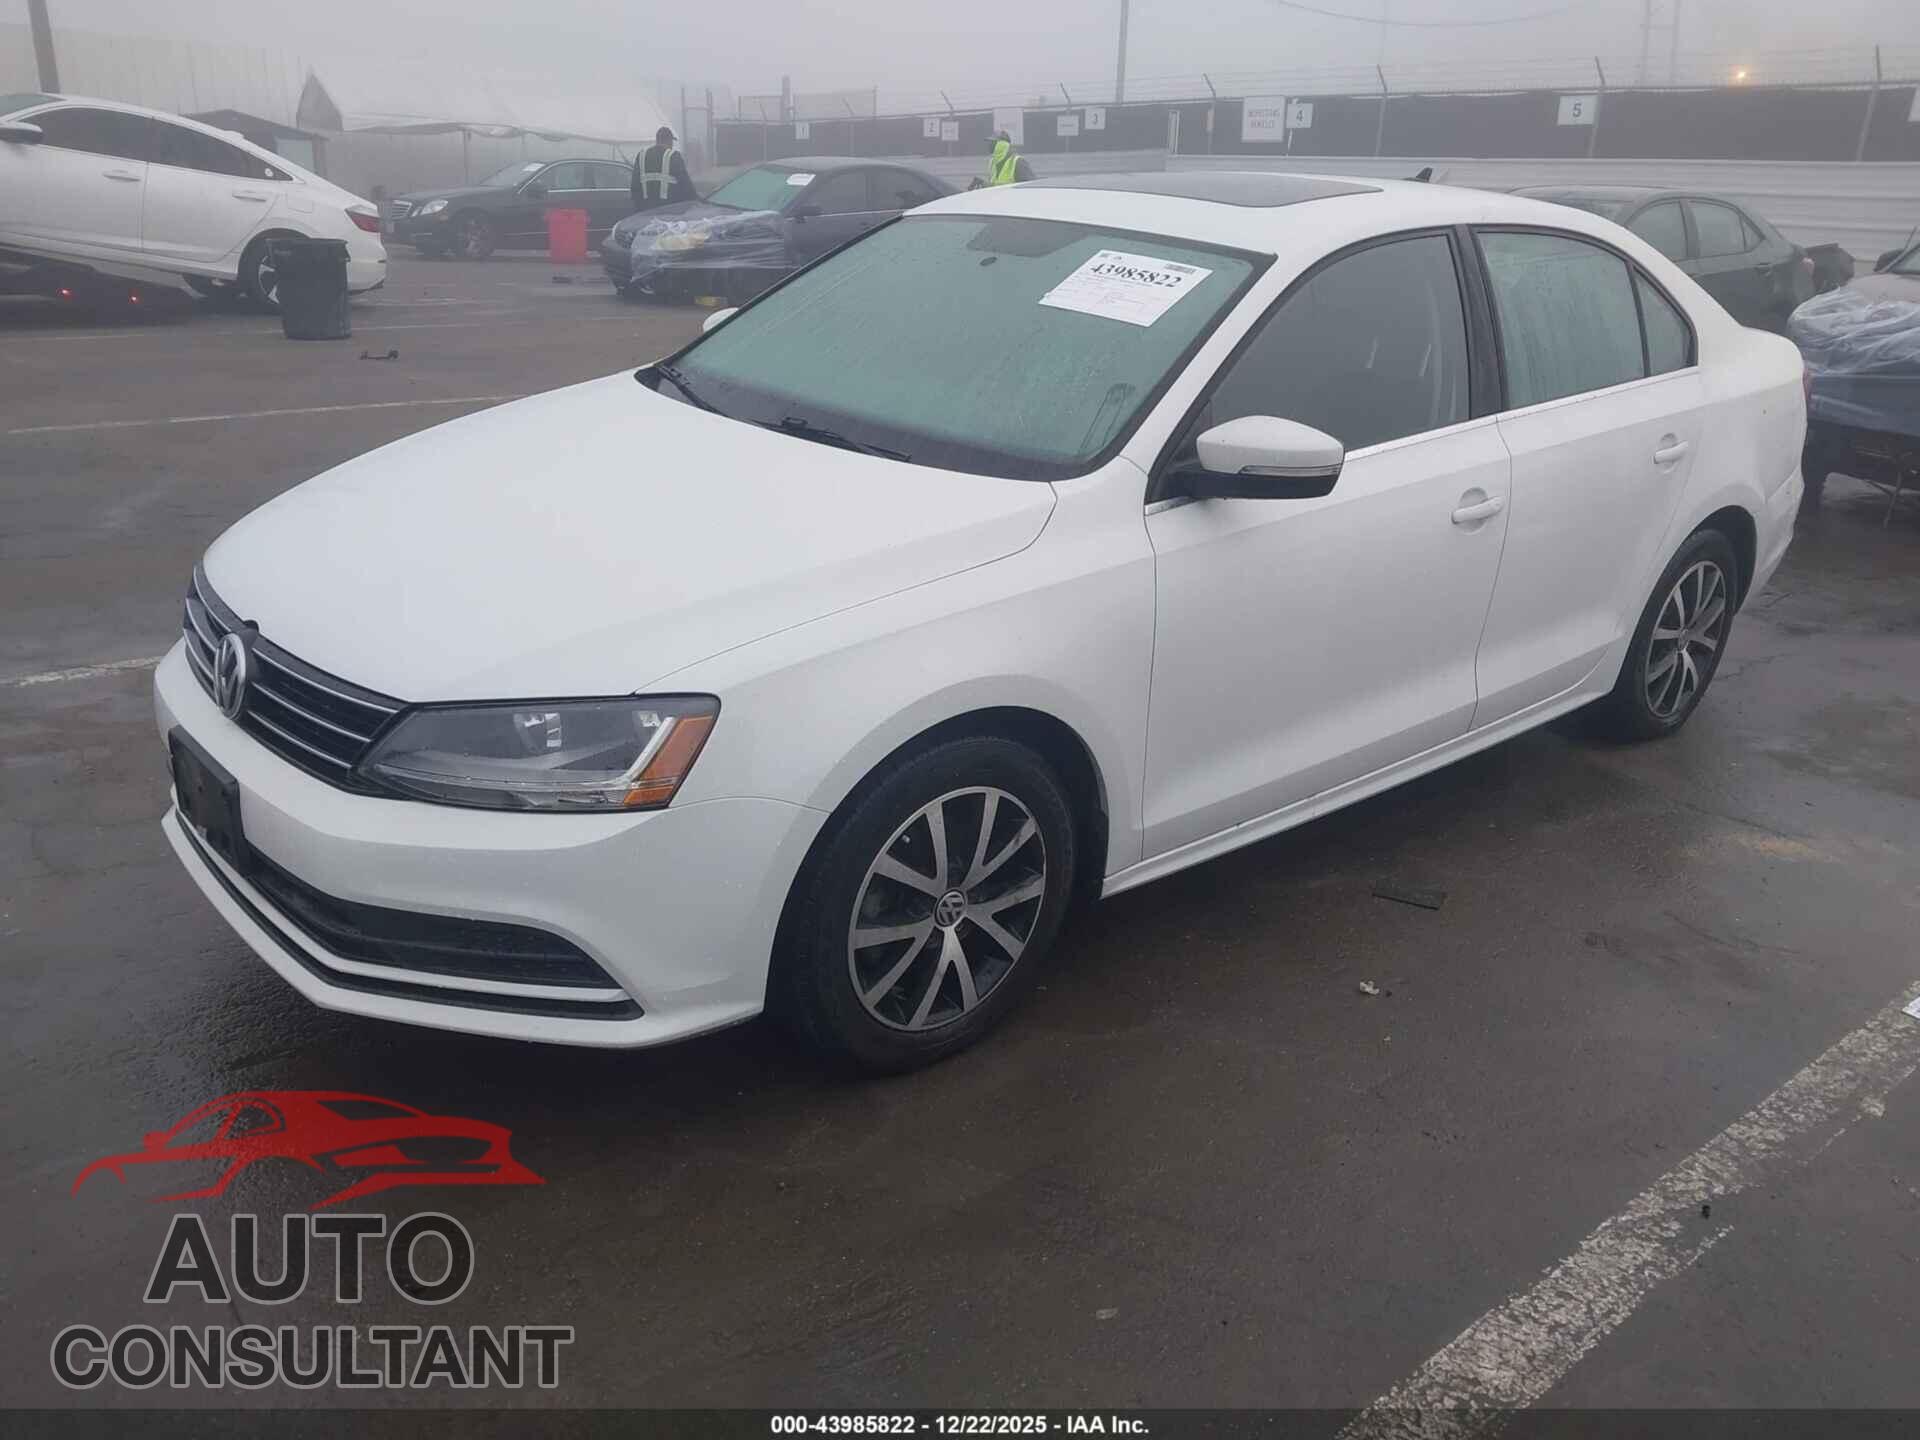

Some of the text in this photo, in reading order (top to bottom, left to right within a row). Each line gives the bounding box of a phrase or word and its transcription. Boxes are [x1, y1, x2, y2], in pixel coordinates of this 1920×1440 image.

[1296, 109, 1304, 122] 4
[1572, 103, 1582, 117] 5
[1089, 263, 1182, 288] 43985822
